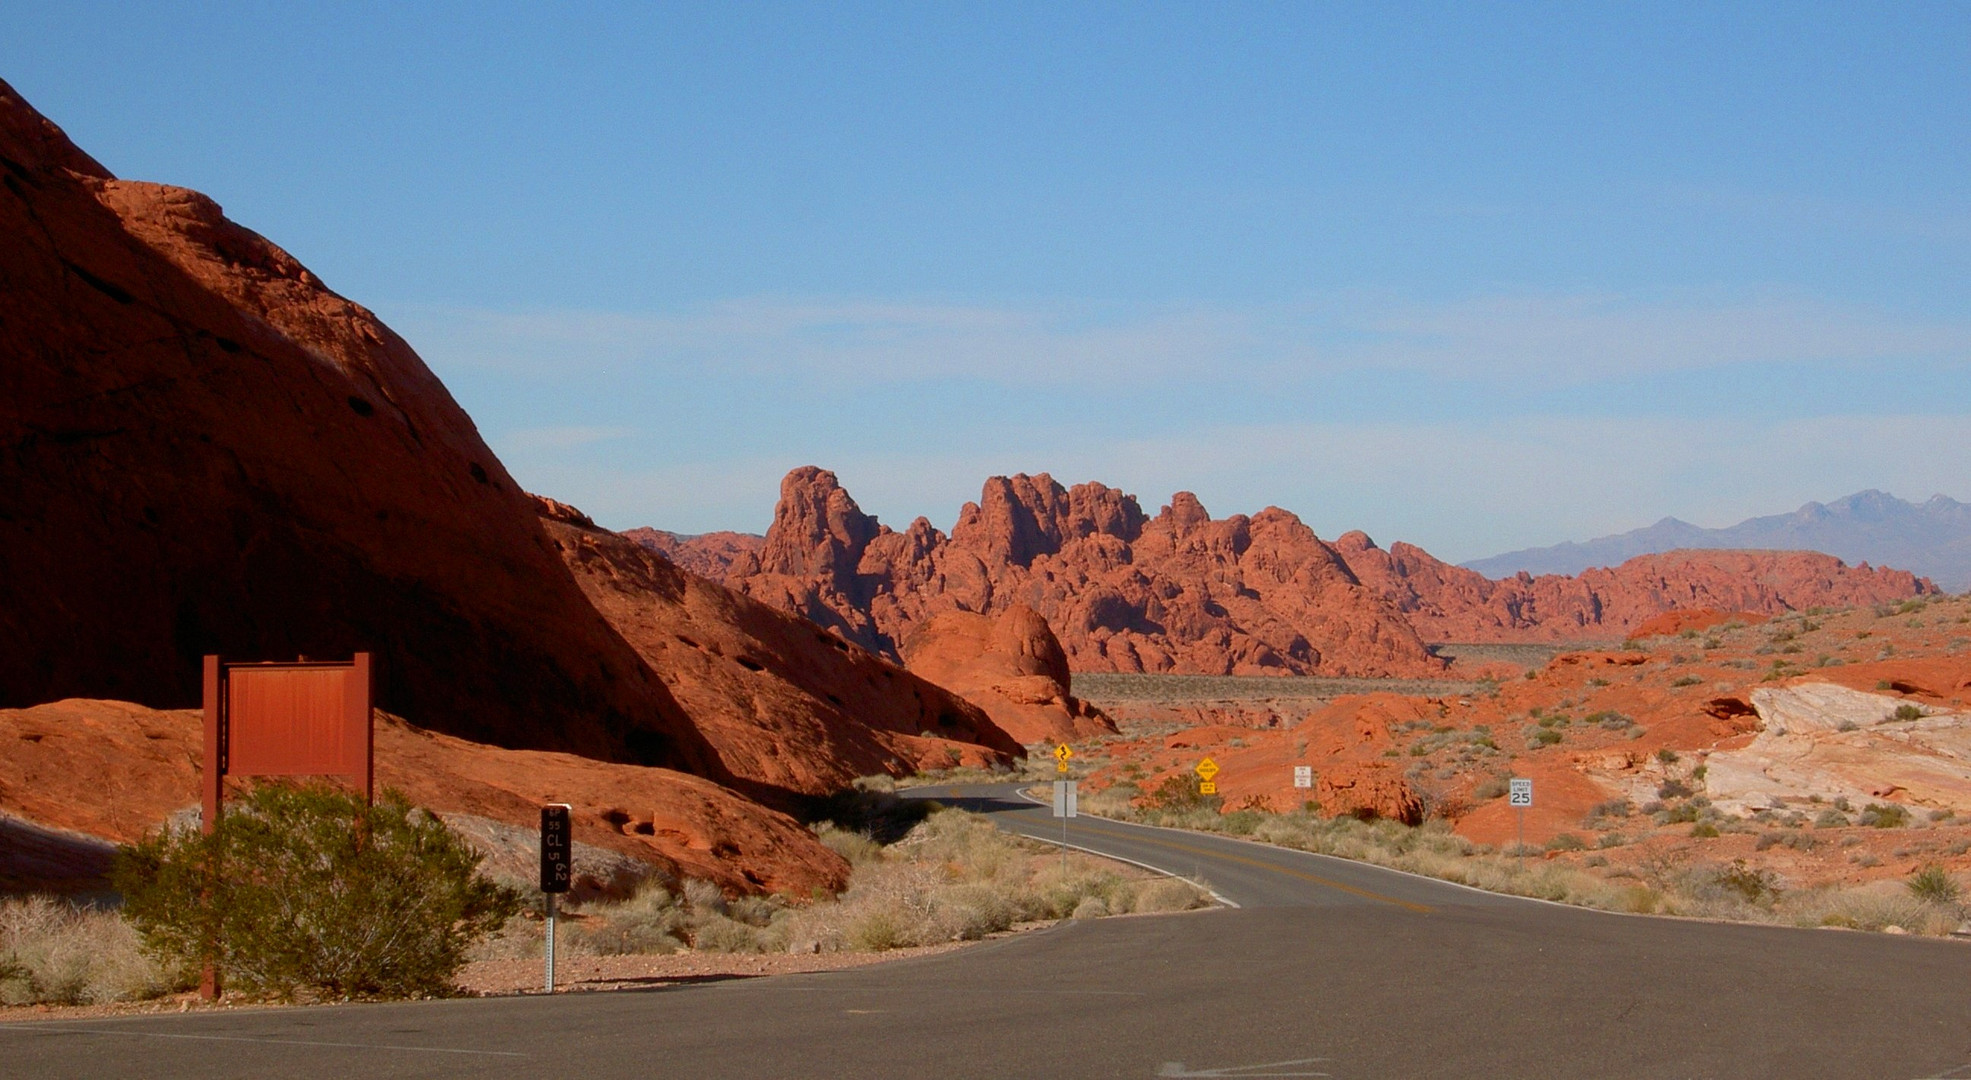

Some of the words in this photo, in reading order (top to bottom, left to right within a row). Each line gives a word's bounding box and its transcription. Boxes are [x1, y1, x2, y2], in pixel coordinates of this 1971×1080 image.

[1512, 792, 1530, 804] 25
[549, 821, 561, 830] 55
[546, 833, 564, 846] CL
[548, 852, 560, 860] 5
[555, 862, 567, 880] 62
